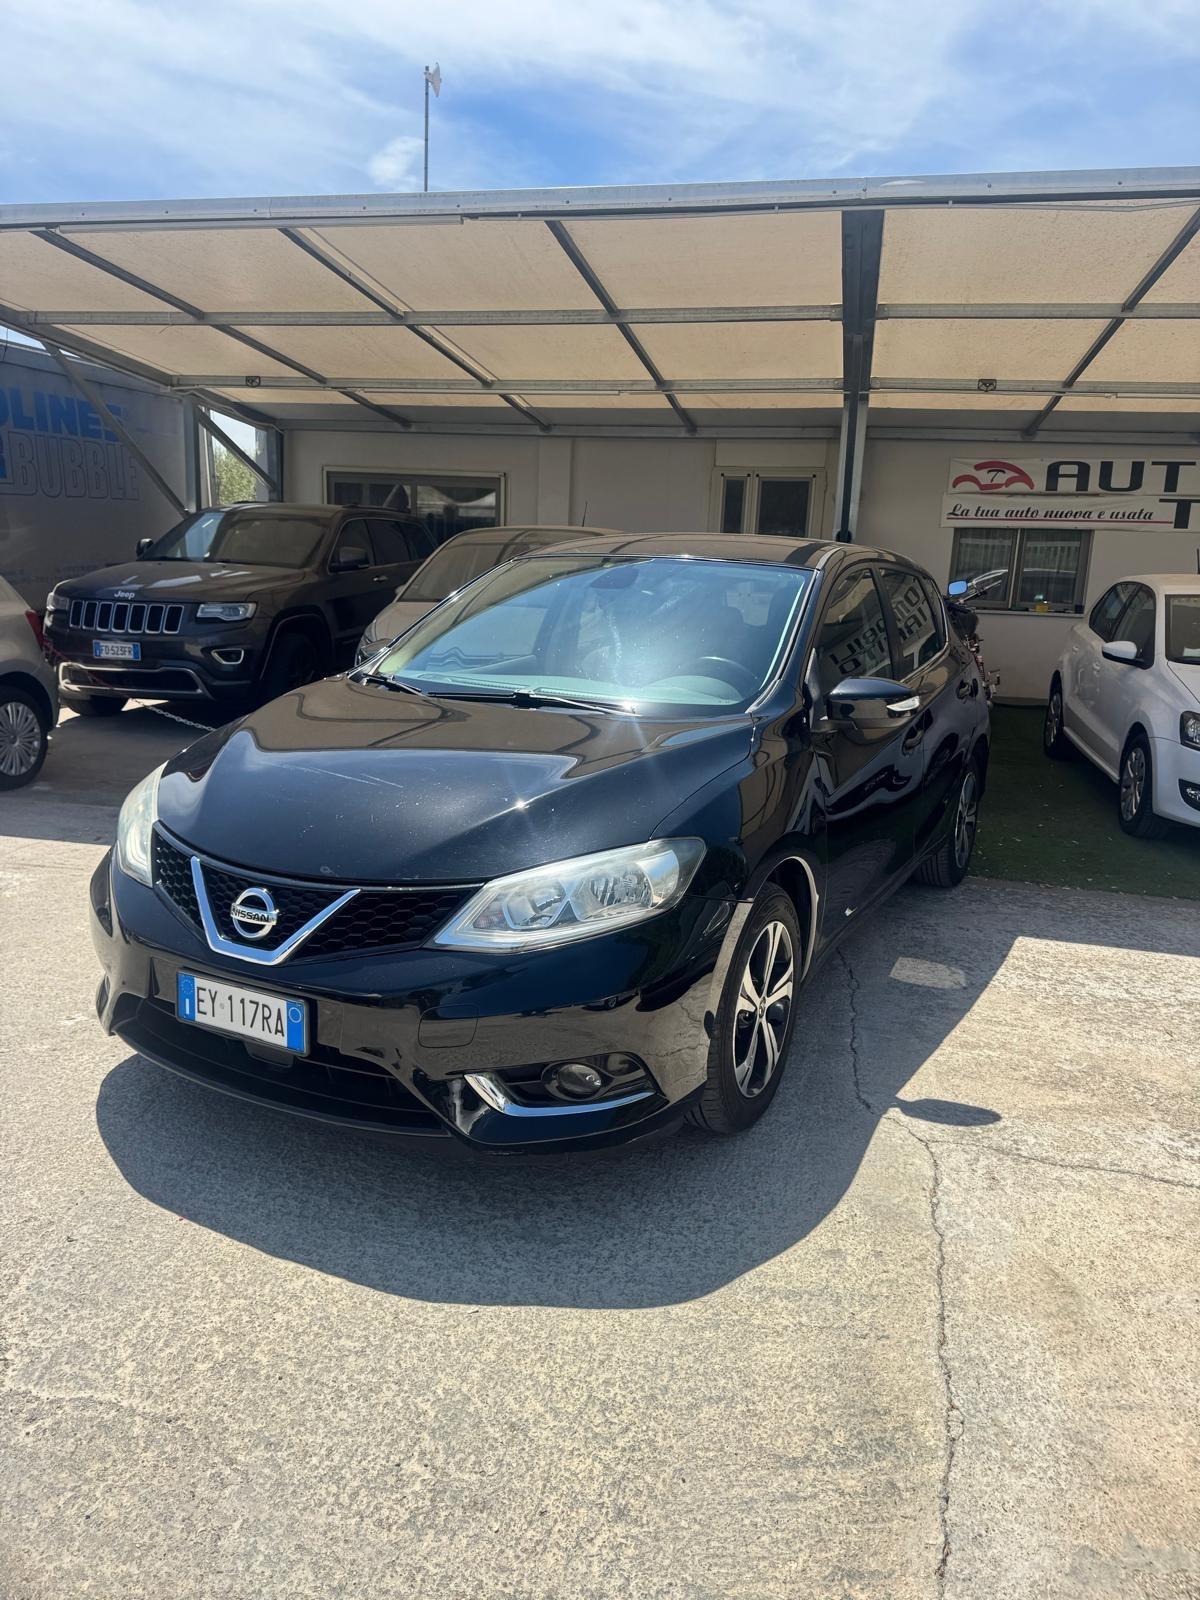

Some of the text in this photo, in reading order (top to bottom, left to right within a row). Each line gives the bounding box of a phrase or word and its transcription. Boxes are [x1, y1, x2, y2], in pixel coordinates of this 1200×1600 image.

[8, 431, 140, 500] BUBBLE
[1045, 461, 1197, 492] AUT
[947, 503, 1153, 520] La tua auto nuova e usata
[114, 591, 135, 600] Jeep
[231, 906, 270, 923] NISSAN
